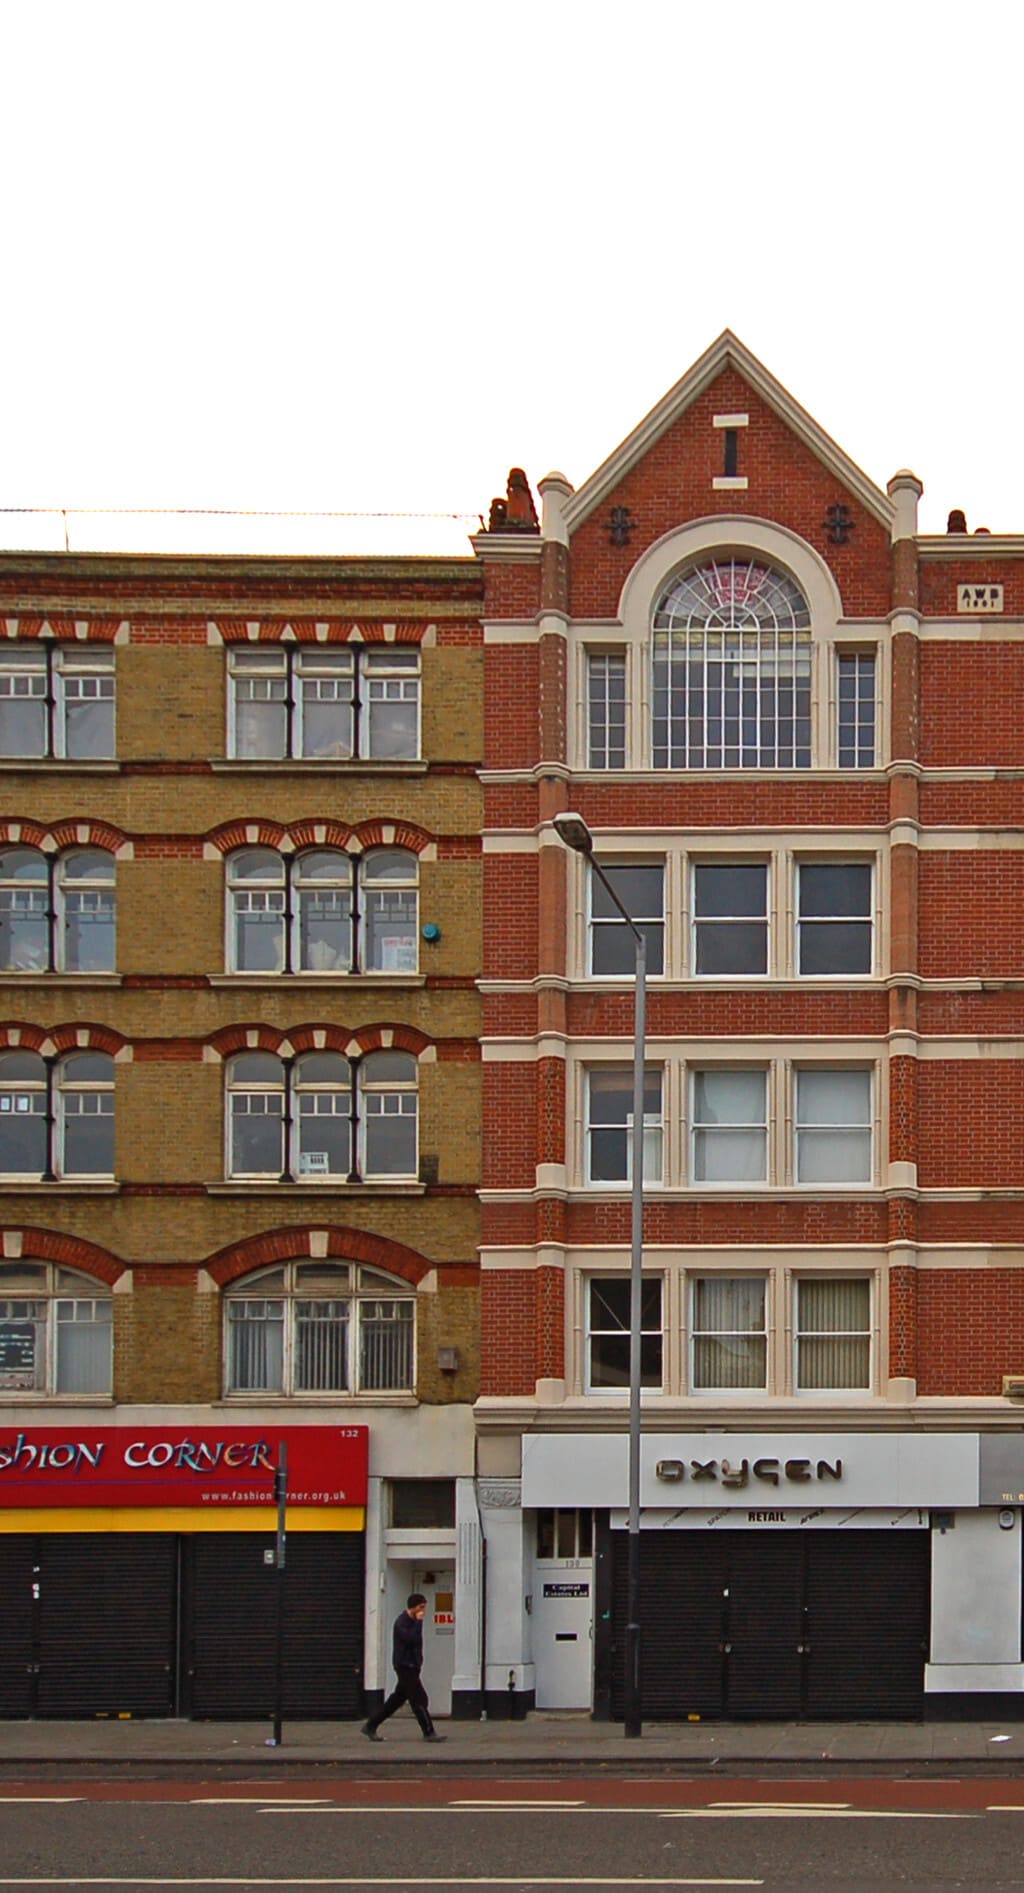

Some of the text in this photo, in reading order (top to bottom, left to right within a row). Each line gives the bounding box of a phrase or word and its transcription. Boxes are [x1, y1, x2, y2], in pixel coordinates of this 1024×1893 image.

[124, 1438, 276, 1472] CORNER
[656, 1459, 842, 1488] OXYGEN
[202, 1491, 346, 1502] www.fashionrner.org.uk
[748, 1511, 786, 1522] RETAIL
